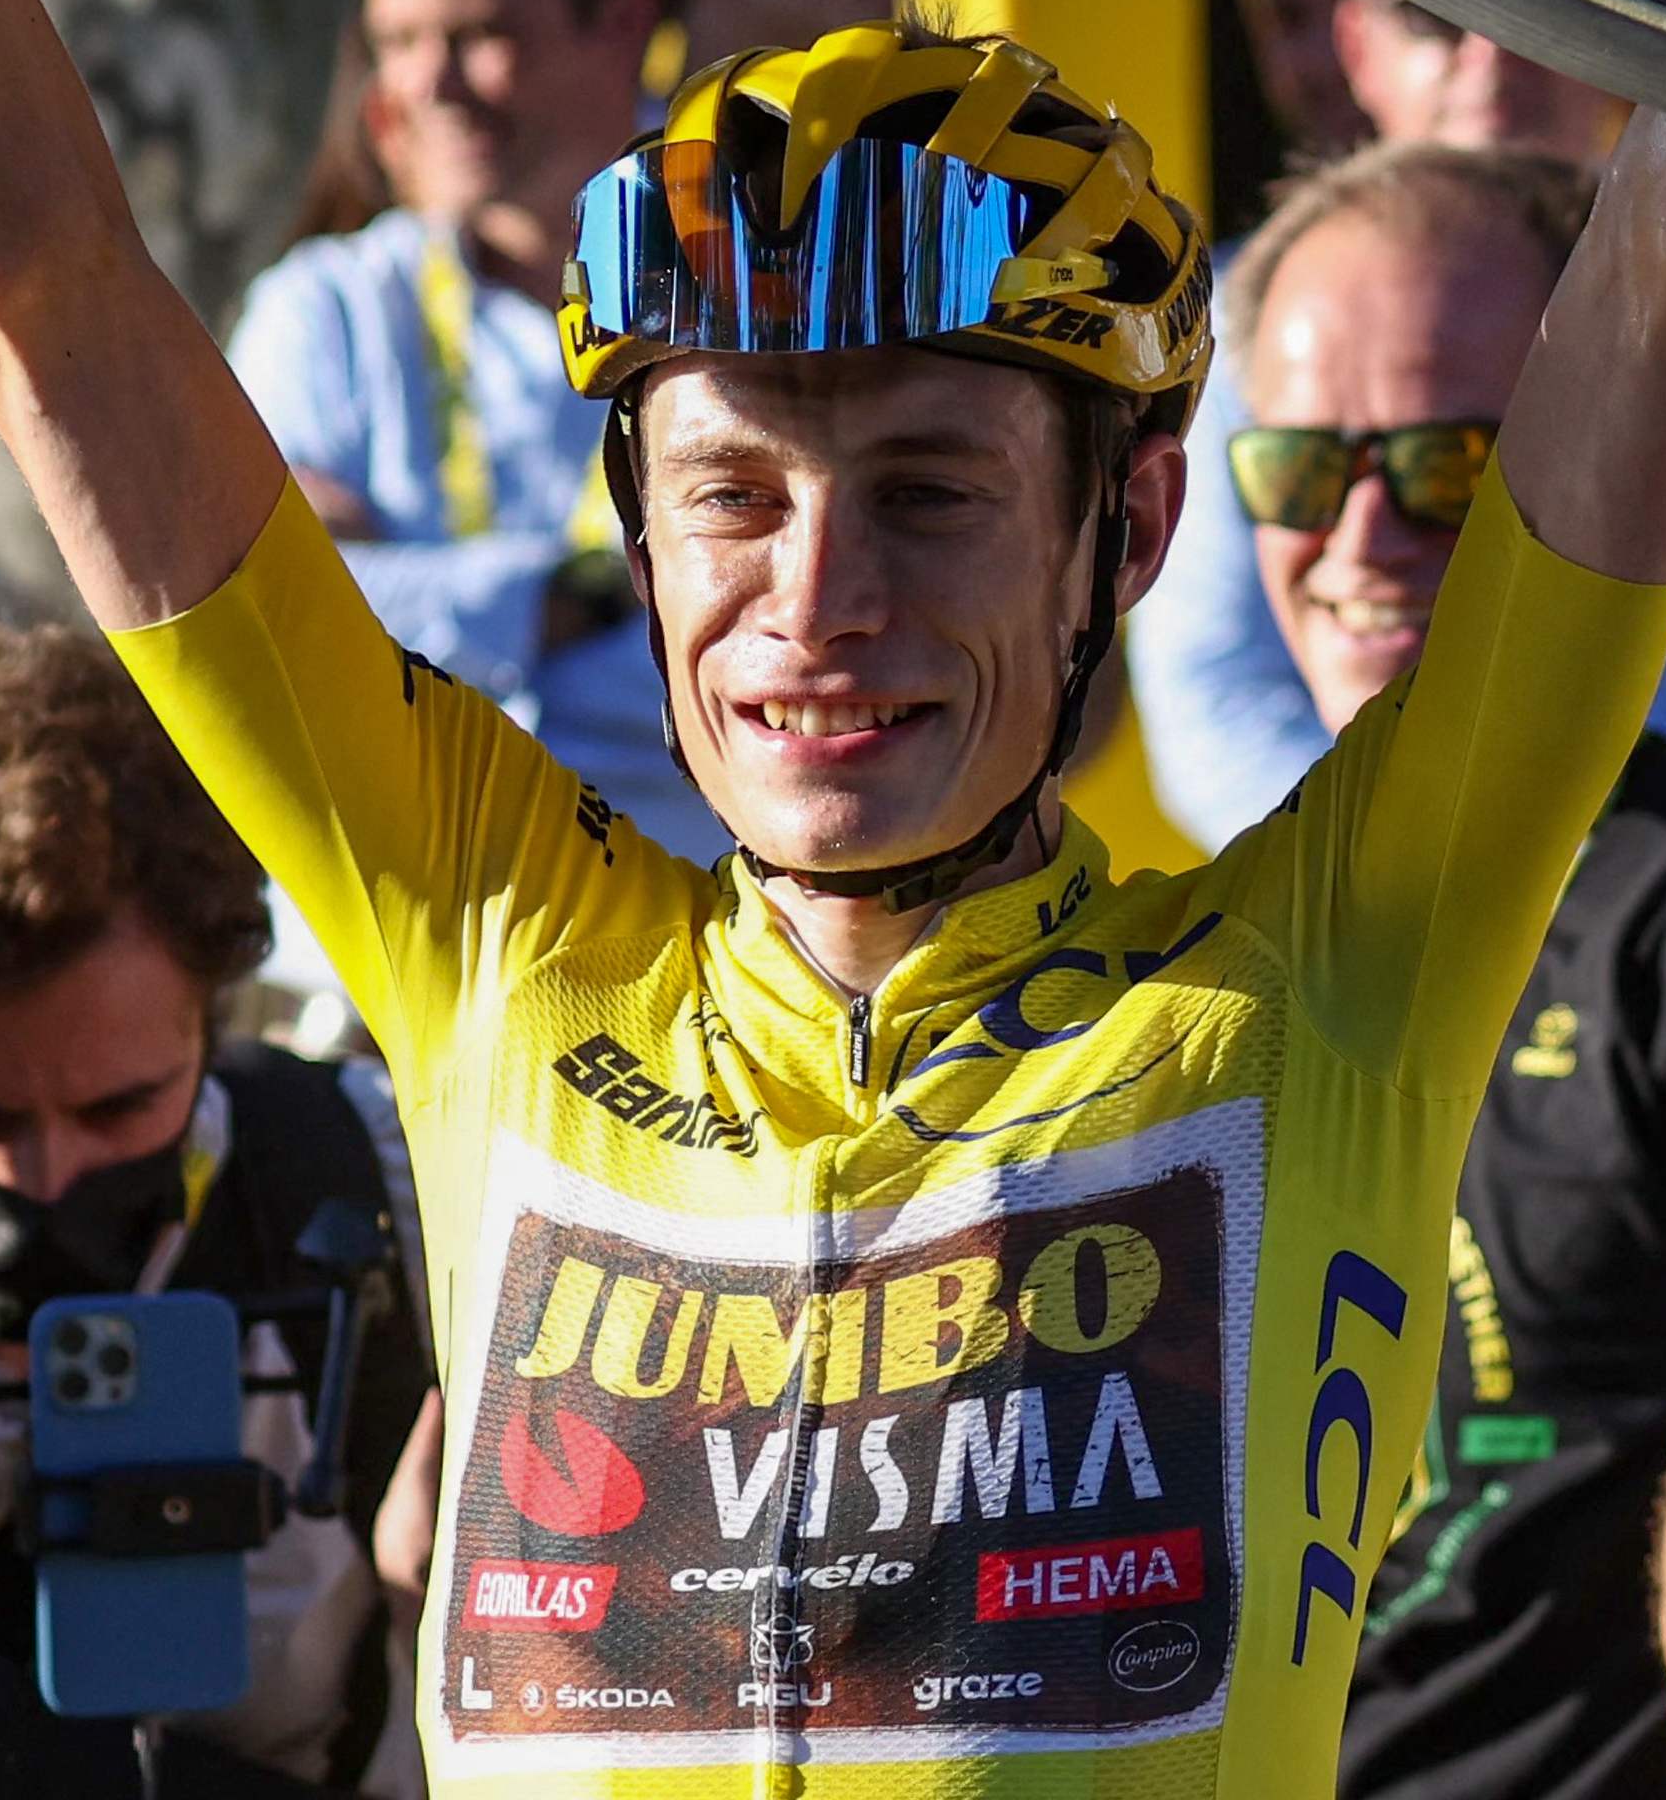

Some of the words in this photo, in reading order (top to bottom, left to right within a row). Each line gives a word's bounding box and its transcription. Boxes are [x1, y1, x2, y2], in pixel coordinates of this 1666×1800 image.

[516, 1223, 1161, 1407] JUMBO
[703, 1372, 1163, 1540] VISMA
[1291, 1250, 1408, 1668] LCL
[474, 1571, 594, 1620] GORILLAS
[670, 1552, 915, 1593] cervélo
[1003, 1546, 1179, 1608] HEMA
[1113, 1638, 1193, 1676] Campina
[460, 1655, 493, 1710] L
[555, 1683, 675, 1708] ŠKODA
[737, 1682, 832, 1708] AGU
[912, 1671, 1044, 1710] graze
